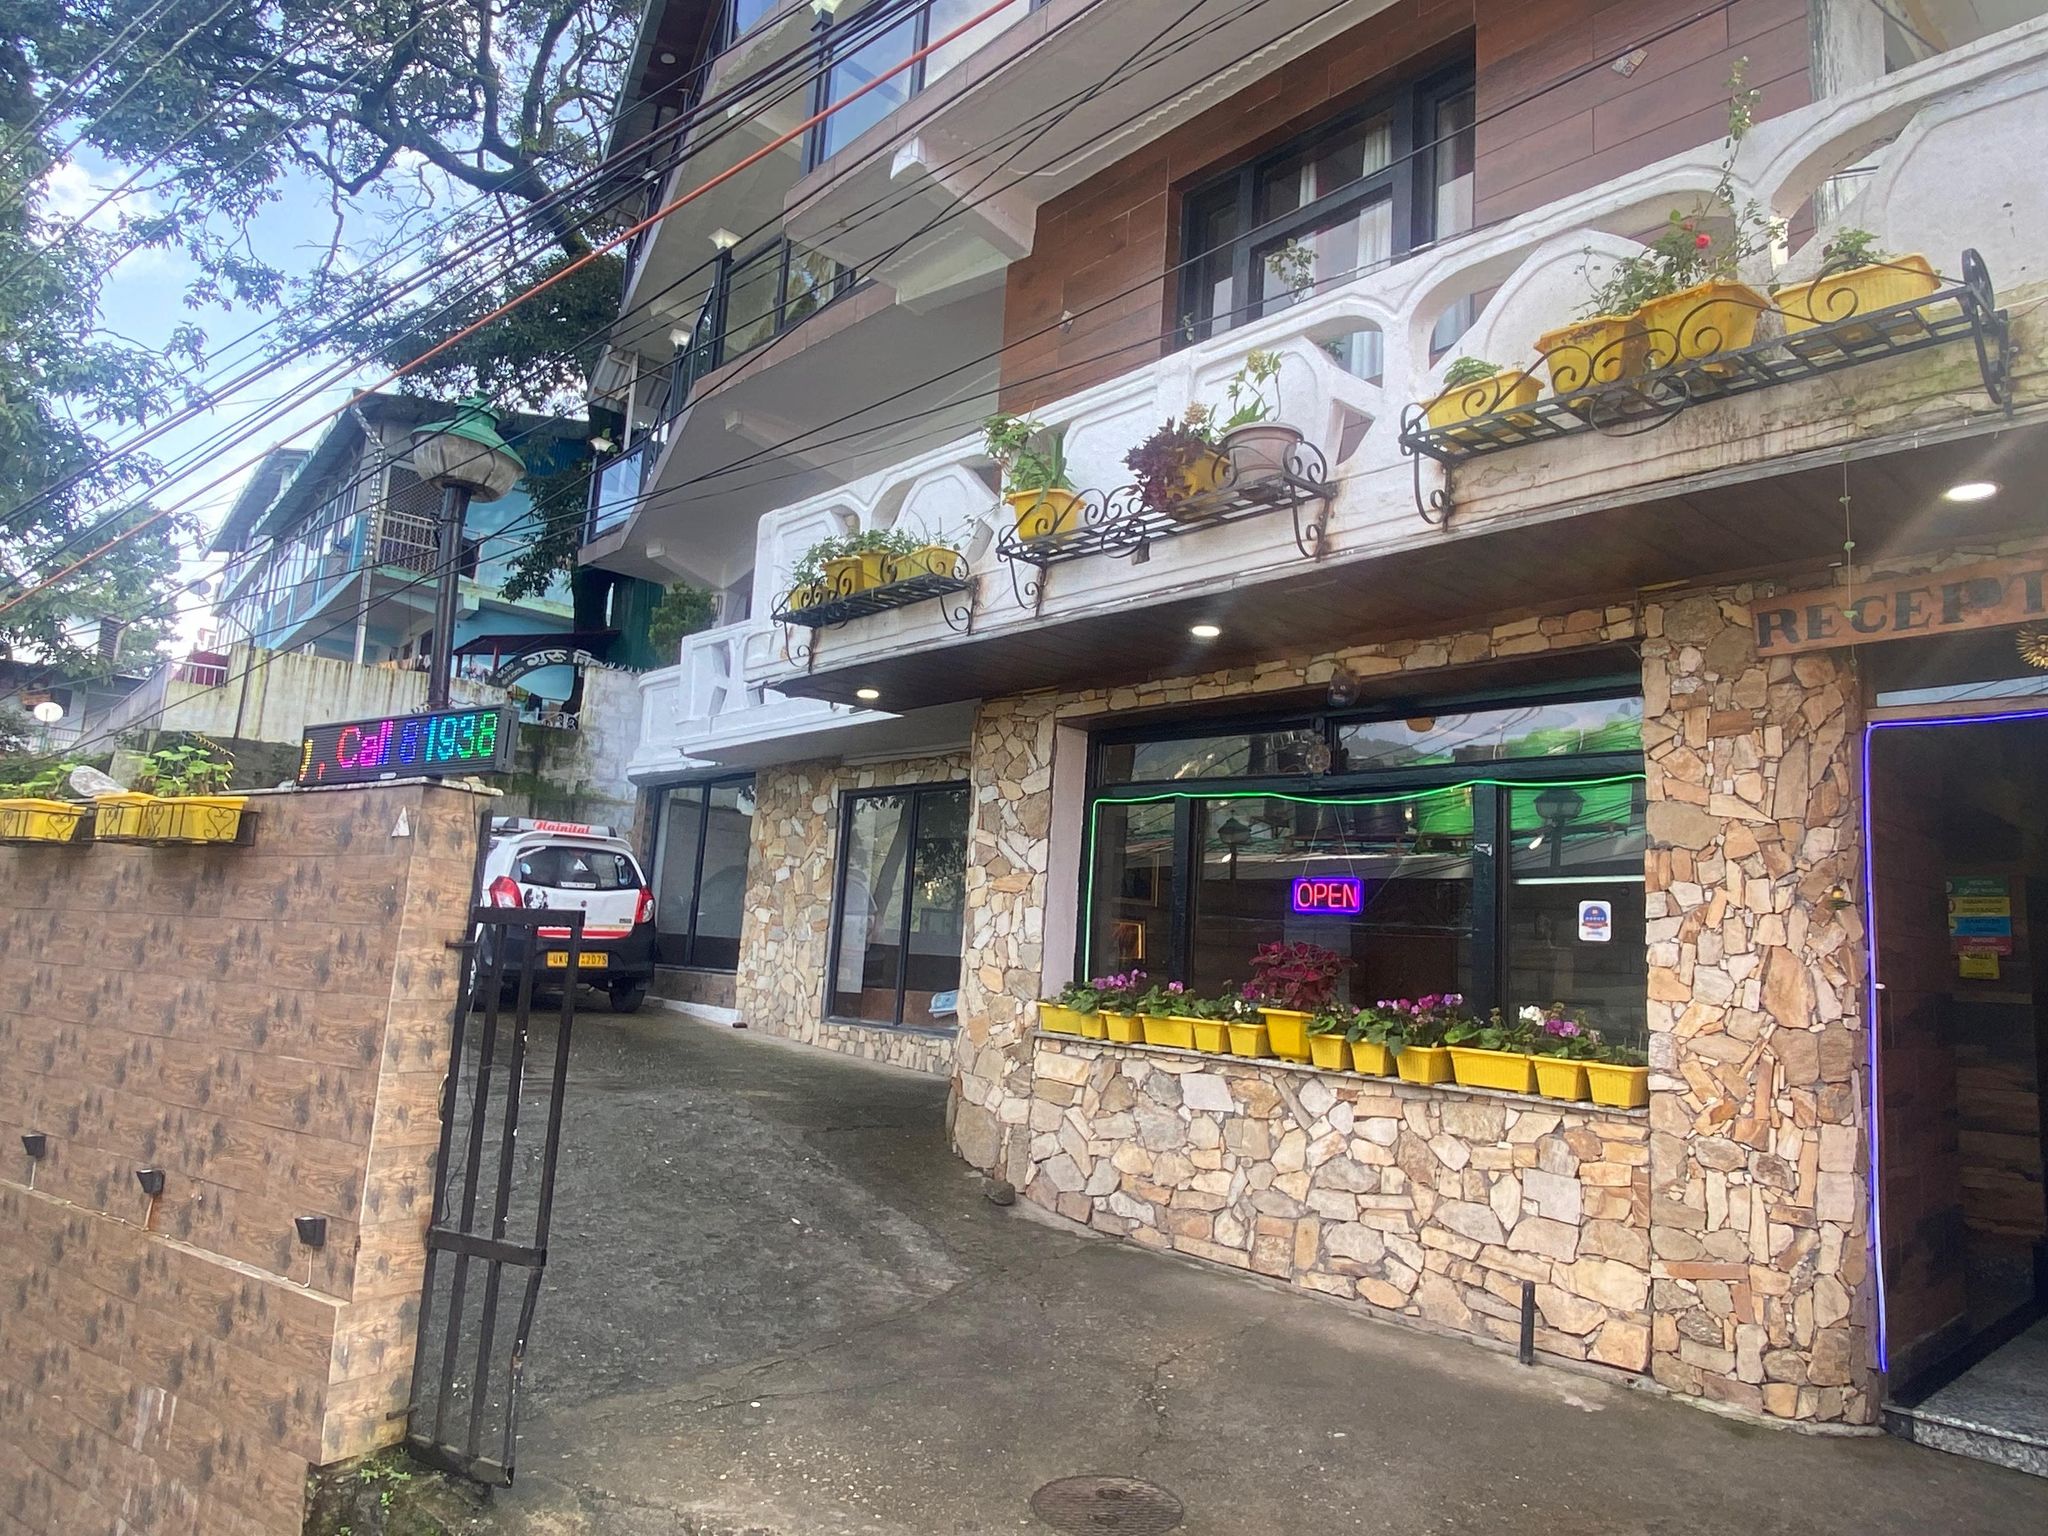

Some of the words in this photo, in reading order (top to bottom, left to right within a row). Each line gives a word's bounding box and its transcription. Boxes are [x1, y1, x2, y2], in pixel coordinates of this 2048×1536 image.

[336, 719, 394, 768] Call
[400, 712, 498, 763] 81938
[533, 819, 591, 834] Nainital
[1297, 882, 1357, 908] OPEN
